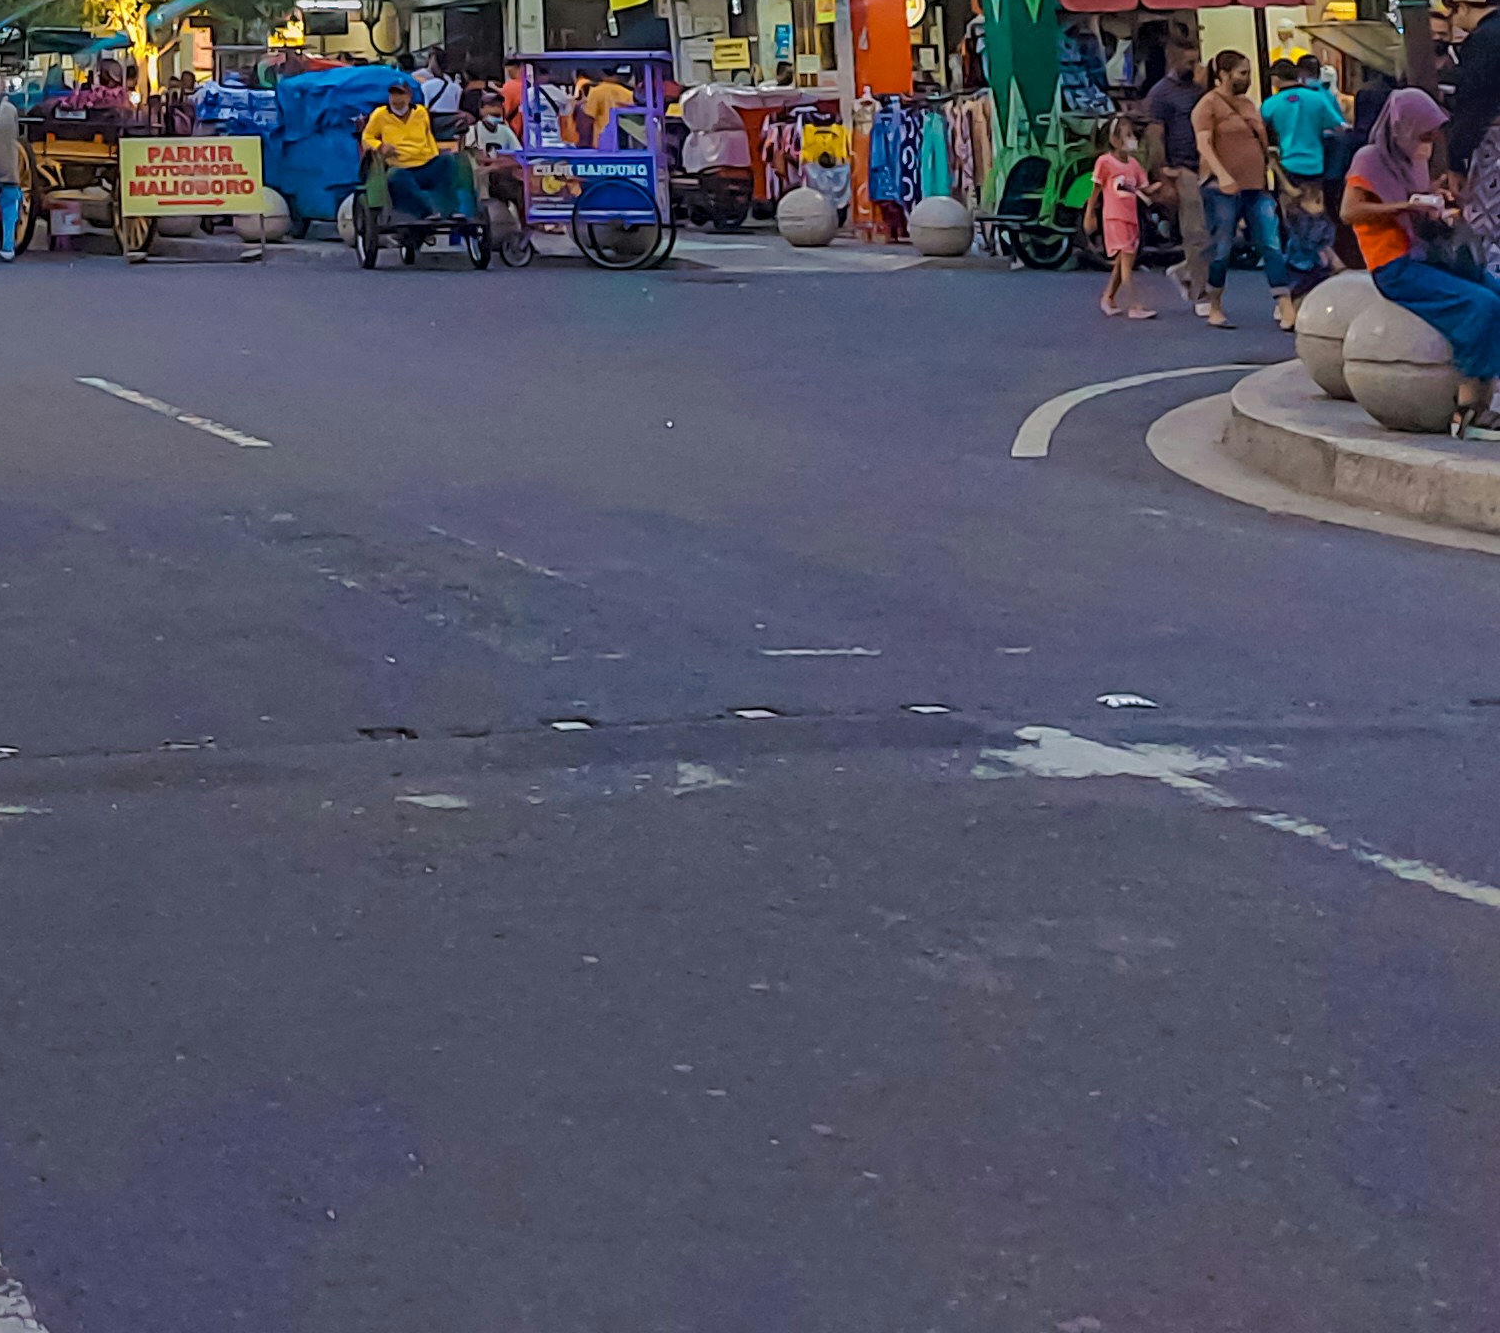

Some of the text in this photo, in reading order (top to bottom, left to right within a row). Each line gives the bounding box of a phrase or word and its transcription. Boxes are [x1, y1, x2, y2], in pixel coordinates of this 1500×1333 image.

[147, 145, 234, 164] PARKIR
[576, 164, 648, 176] BANDUNG
[129, 179, 256, 197] MALIOBORO
